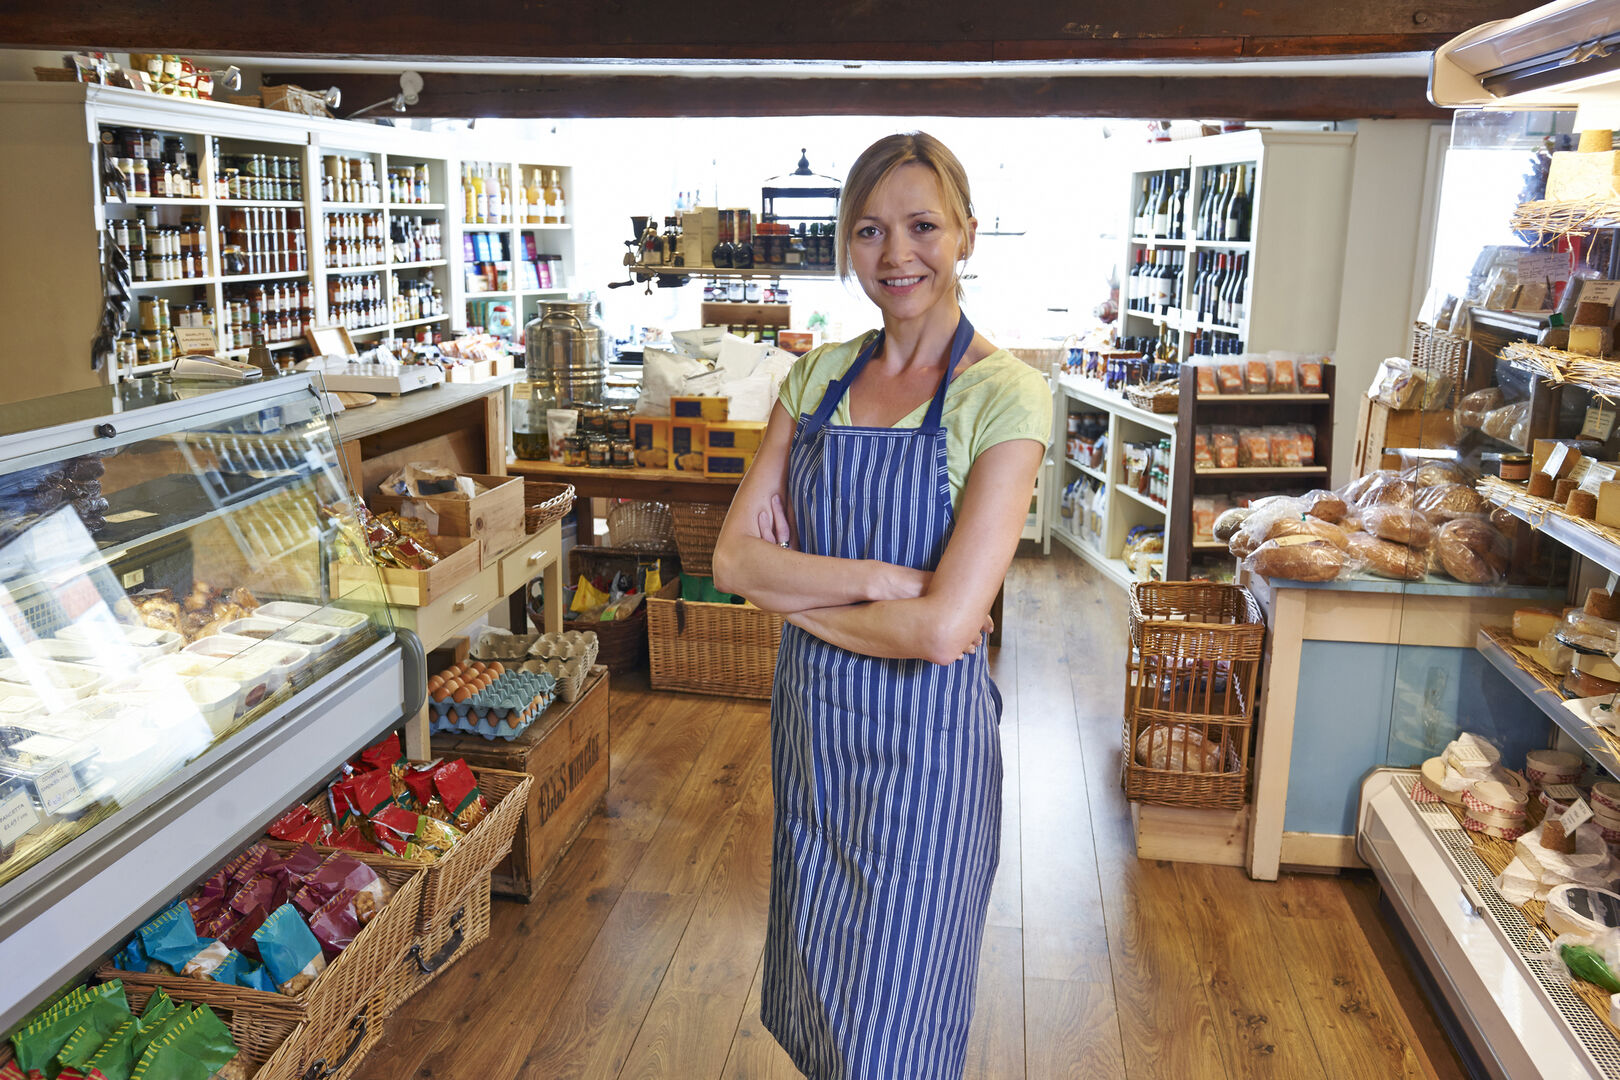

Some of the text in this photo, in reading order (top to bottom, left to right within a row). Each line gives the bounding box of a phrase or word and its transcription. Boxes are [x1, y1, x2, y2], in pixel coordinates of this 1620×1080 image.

[538, 732, 600, 827] EGGS WITH CARE
